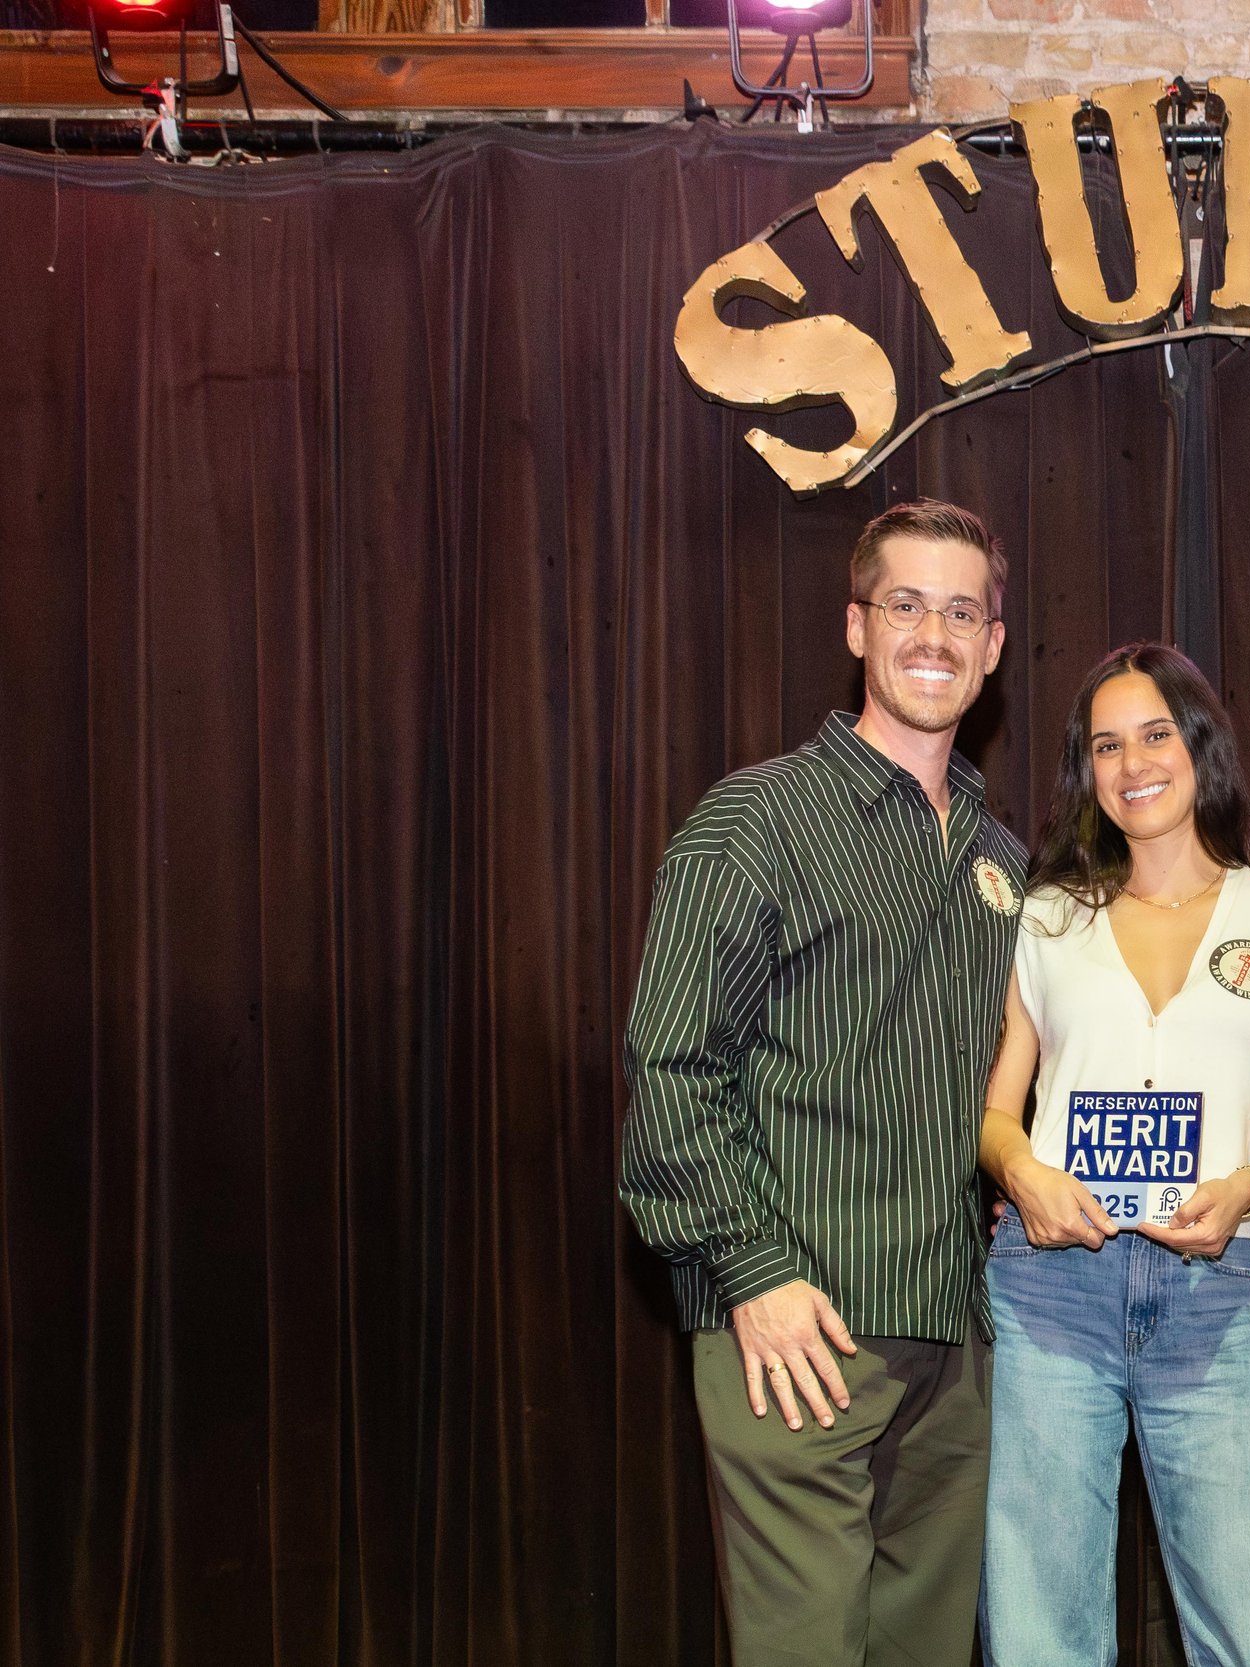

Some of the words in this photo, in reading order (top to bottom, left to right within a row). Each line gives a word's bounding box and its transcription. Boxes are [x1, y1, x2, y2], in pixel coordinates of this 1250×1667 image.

[1211, 964, 1233, 990] AWARD
[1073, 1096, 1198, 1111] PRESERVATION
[1071, 1113, 1197, 1147] MERIT
[1068, 1149, 1194, 1177] AWARD
[1092, 1193, 1139, 1218] 25
